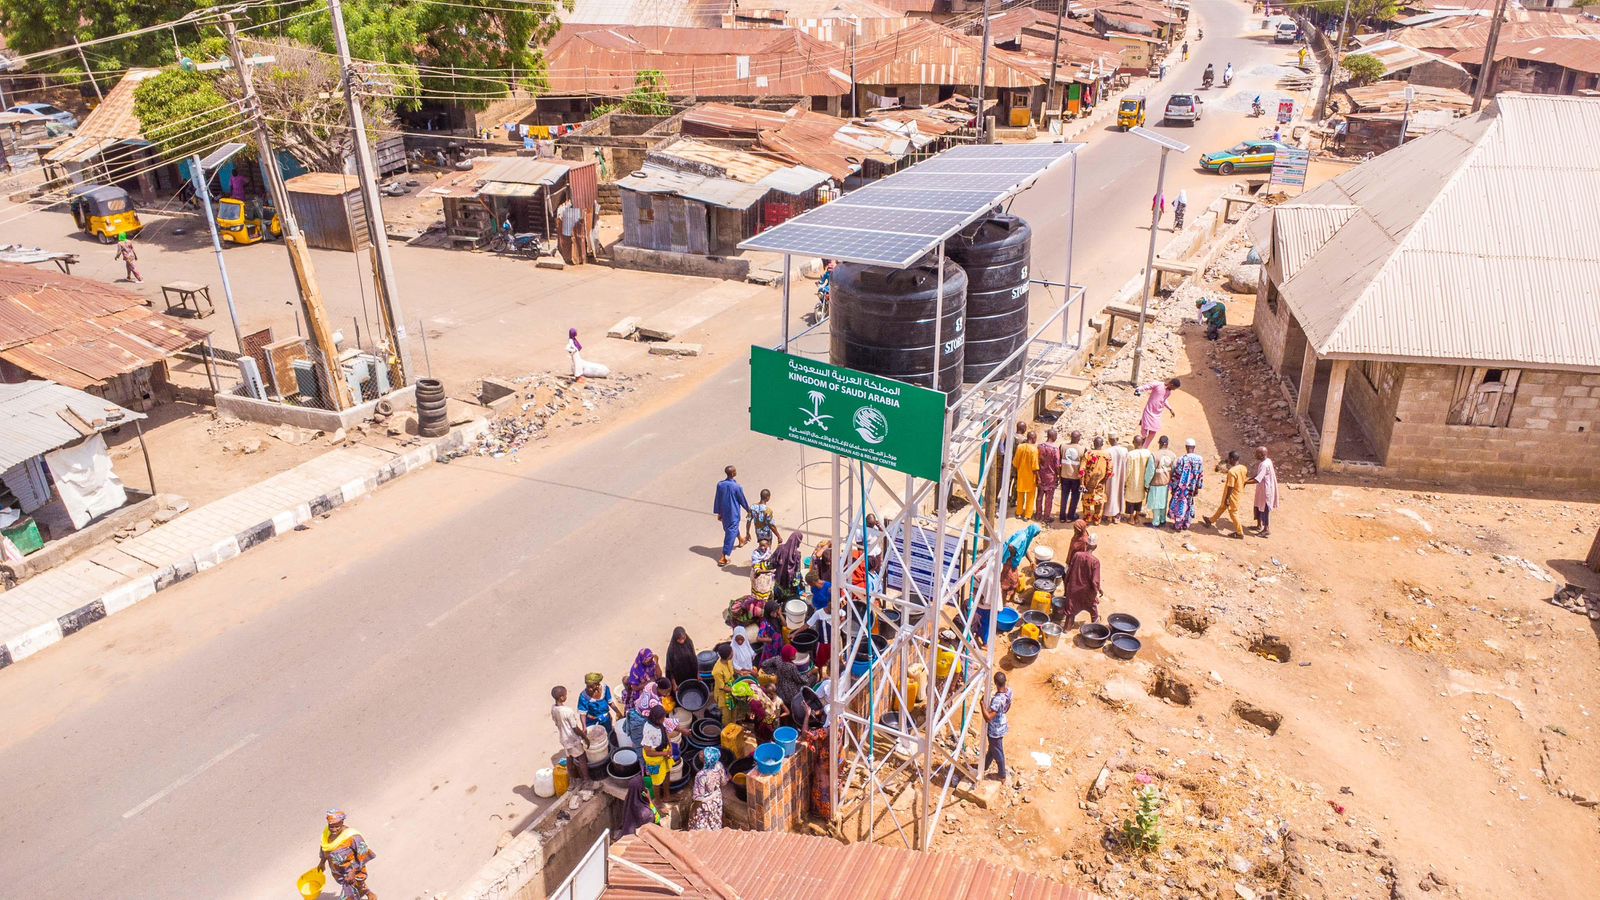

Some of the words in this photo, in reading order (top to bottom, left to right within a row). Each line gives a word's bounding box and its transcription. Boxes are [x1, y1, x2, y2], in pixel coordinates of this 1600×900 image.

[788, 359, 830, 377] السعودية
[831, 370, 862, 386] العربية
[863, 378, 900, 396] المملكة
[788, 372, 828, 389] KINGDOM
[828, 382, 840, 392] OF
[841, 385, 867, 400] SAUDI
[867, 392, 900, 408] ARABIA
[788, 432, 799, 440] KING
[799, 435, 818, 445] SALMAN
[818, 441, 851, 454] HUMANITARIAN
[878, 459, 897, 467] CENTRE
